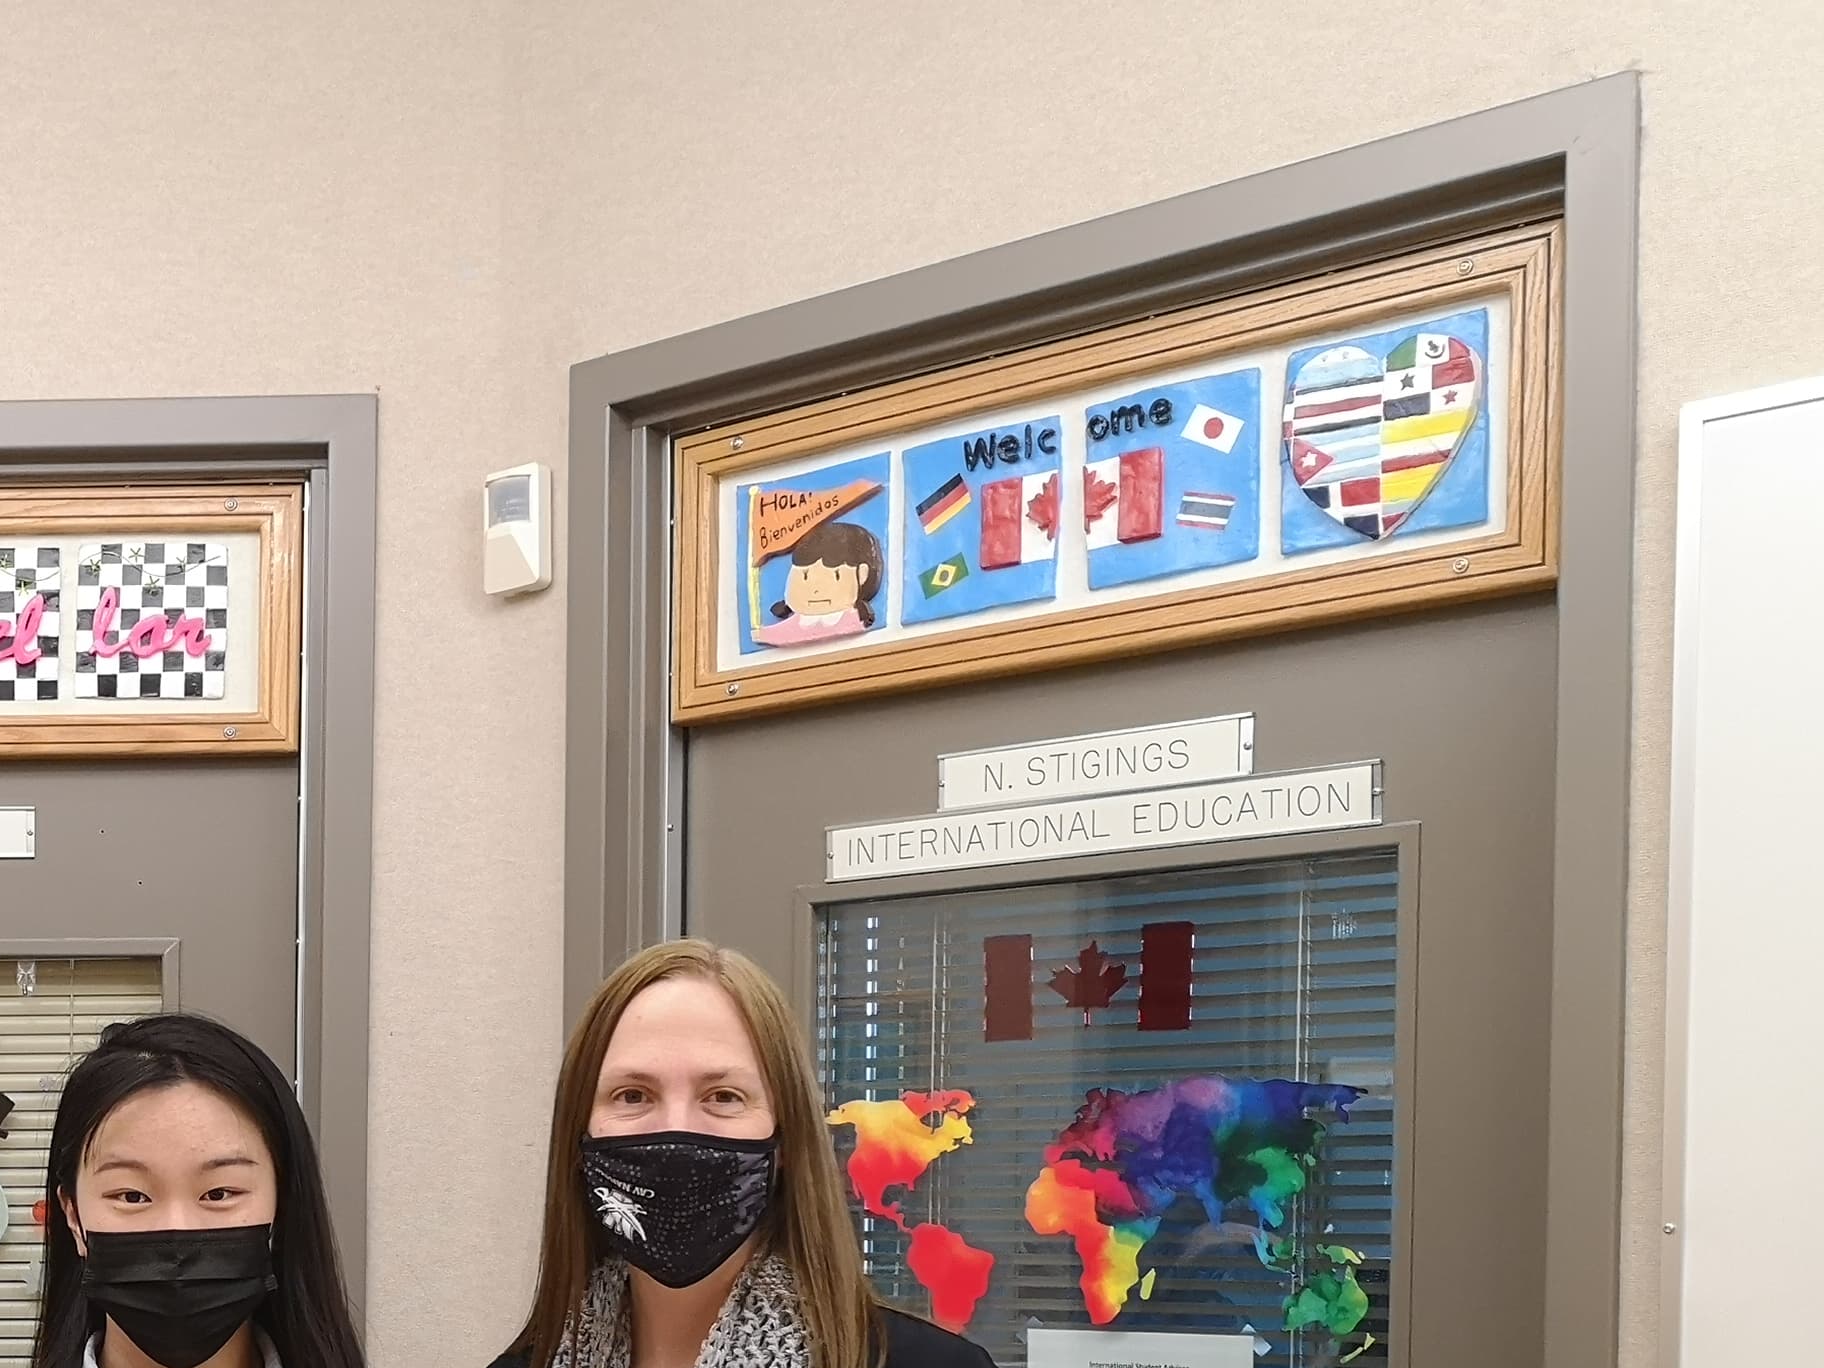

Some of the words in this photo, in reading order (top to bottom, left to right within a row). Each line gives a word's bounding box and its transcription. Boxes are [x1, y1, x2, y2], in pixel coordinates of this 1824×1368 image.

[760, 495, 839, 549] Bienvenidos
[983, 761, 1013, 792] N.
[1026, 739, 1190, 786] STIGINGS
[848, 809, 1111, 866] INTERNATIONAL
[1133, 781, 1351, 835] EDUCATION
